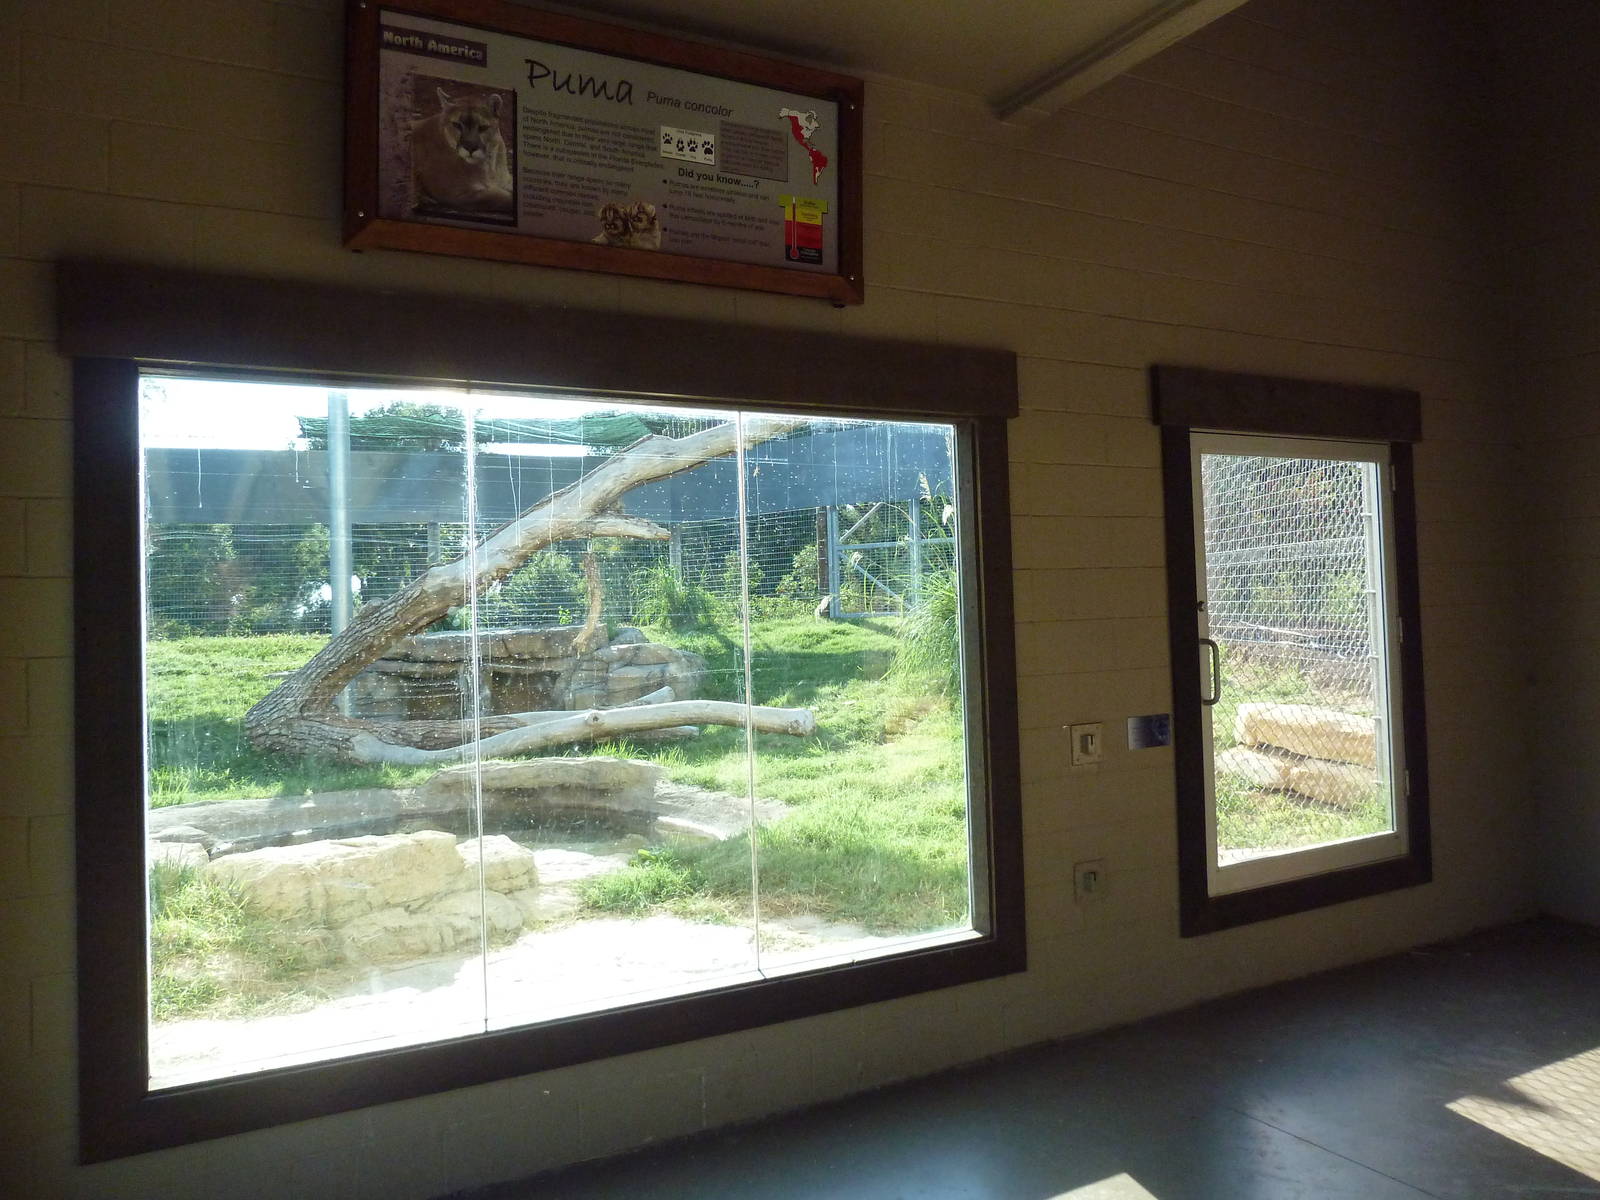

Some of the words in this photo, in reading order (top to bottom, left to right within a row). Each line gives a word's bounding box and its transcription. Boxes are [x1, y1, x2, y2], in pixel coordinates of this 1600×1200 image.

[383, 31, 423, 49] North
[427, 39, 483, 60] America
[524, 58, 633, 106] Puma
[646, 91, 681, 109] Puma
[684, 100, 734, 119] concolor
[678, 168, 694, 179] Did
[696, 172, 714, 181] you
